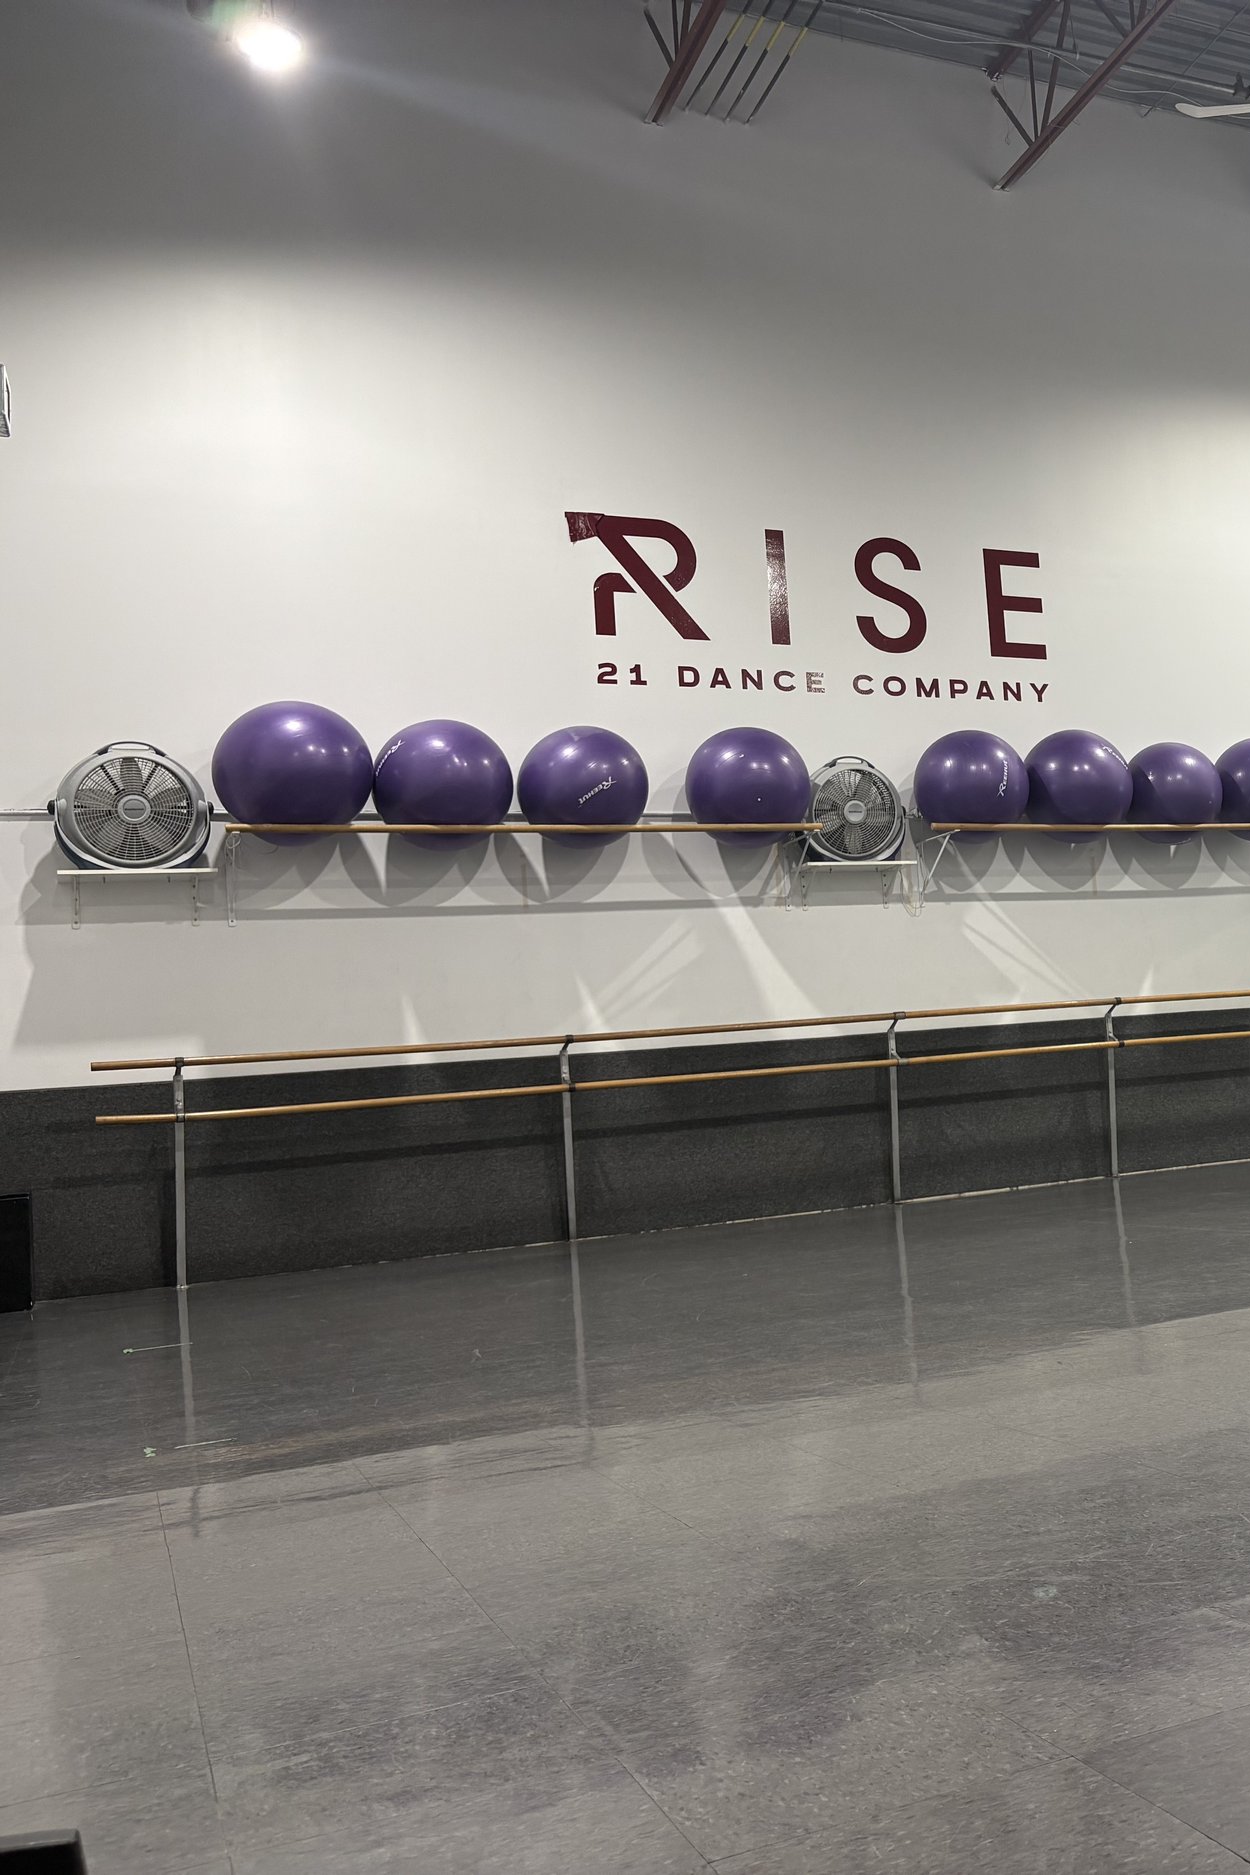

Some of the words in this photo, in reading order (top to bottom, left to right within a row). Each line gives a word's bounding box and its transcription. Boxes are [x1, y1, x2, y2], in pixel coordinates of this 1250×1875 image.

[564, 511, 1048, 660] RISE
[597, 662, 648, 686] 21
[677, 665, 826, 694] DANCE
[852, 674, 1049, 703] COMPANY
